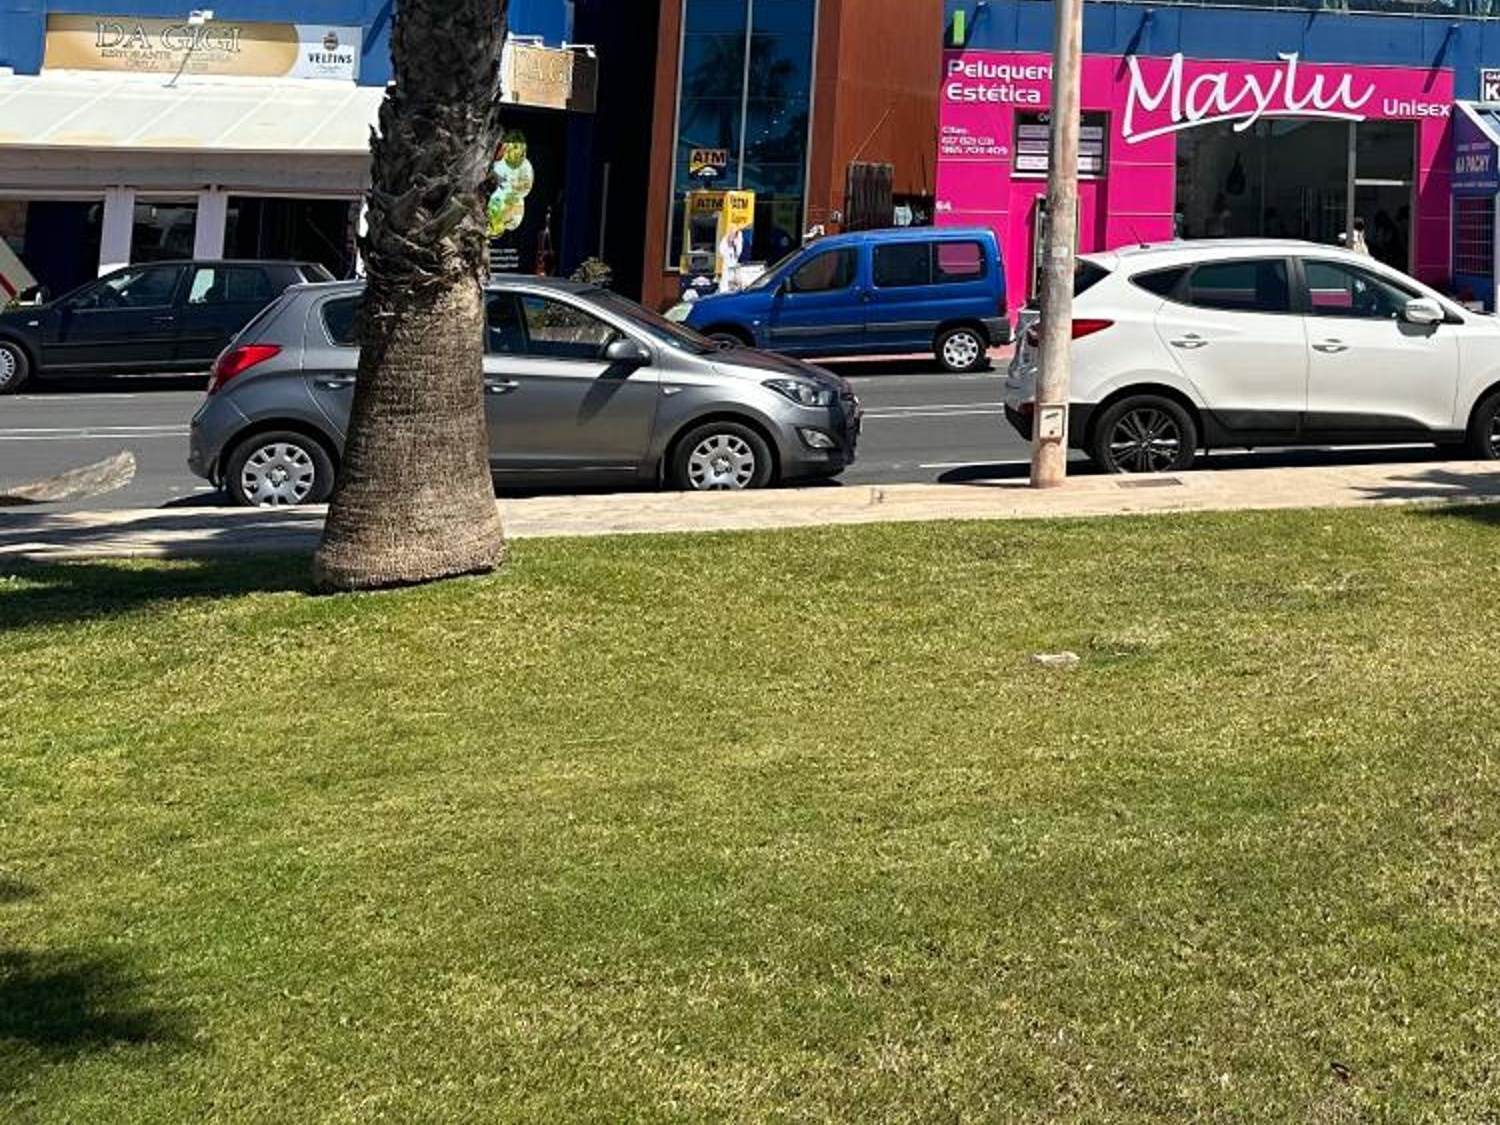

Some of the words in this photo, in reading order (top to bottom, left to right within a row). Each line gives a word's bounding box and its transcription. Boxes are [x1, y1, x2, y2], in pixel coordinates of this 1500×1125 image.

[95, 20, 152, 49] DA
[161, 25, 241, 53] GIGI
[308, 52, 353, 64] VELTINS
[947, 59, 1054, 83] Peluquerí
[946, 82, 1041, 103] Estética
[1121, 52, 1376, 133] Maylu
[1383, 98, 1451, 118] Unisex
[694, 151, 725, 164] ATM
